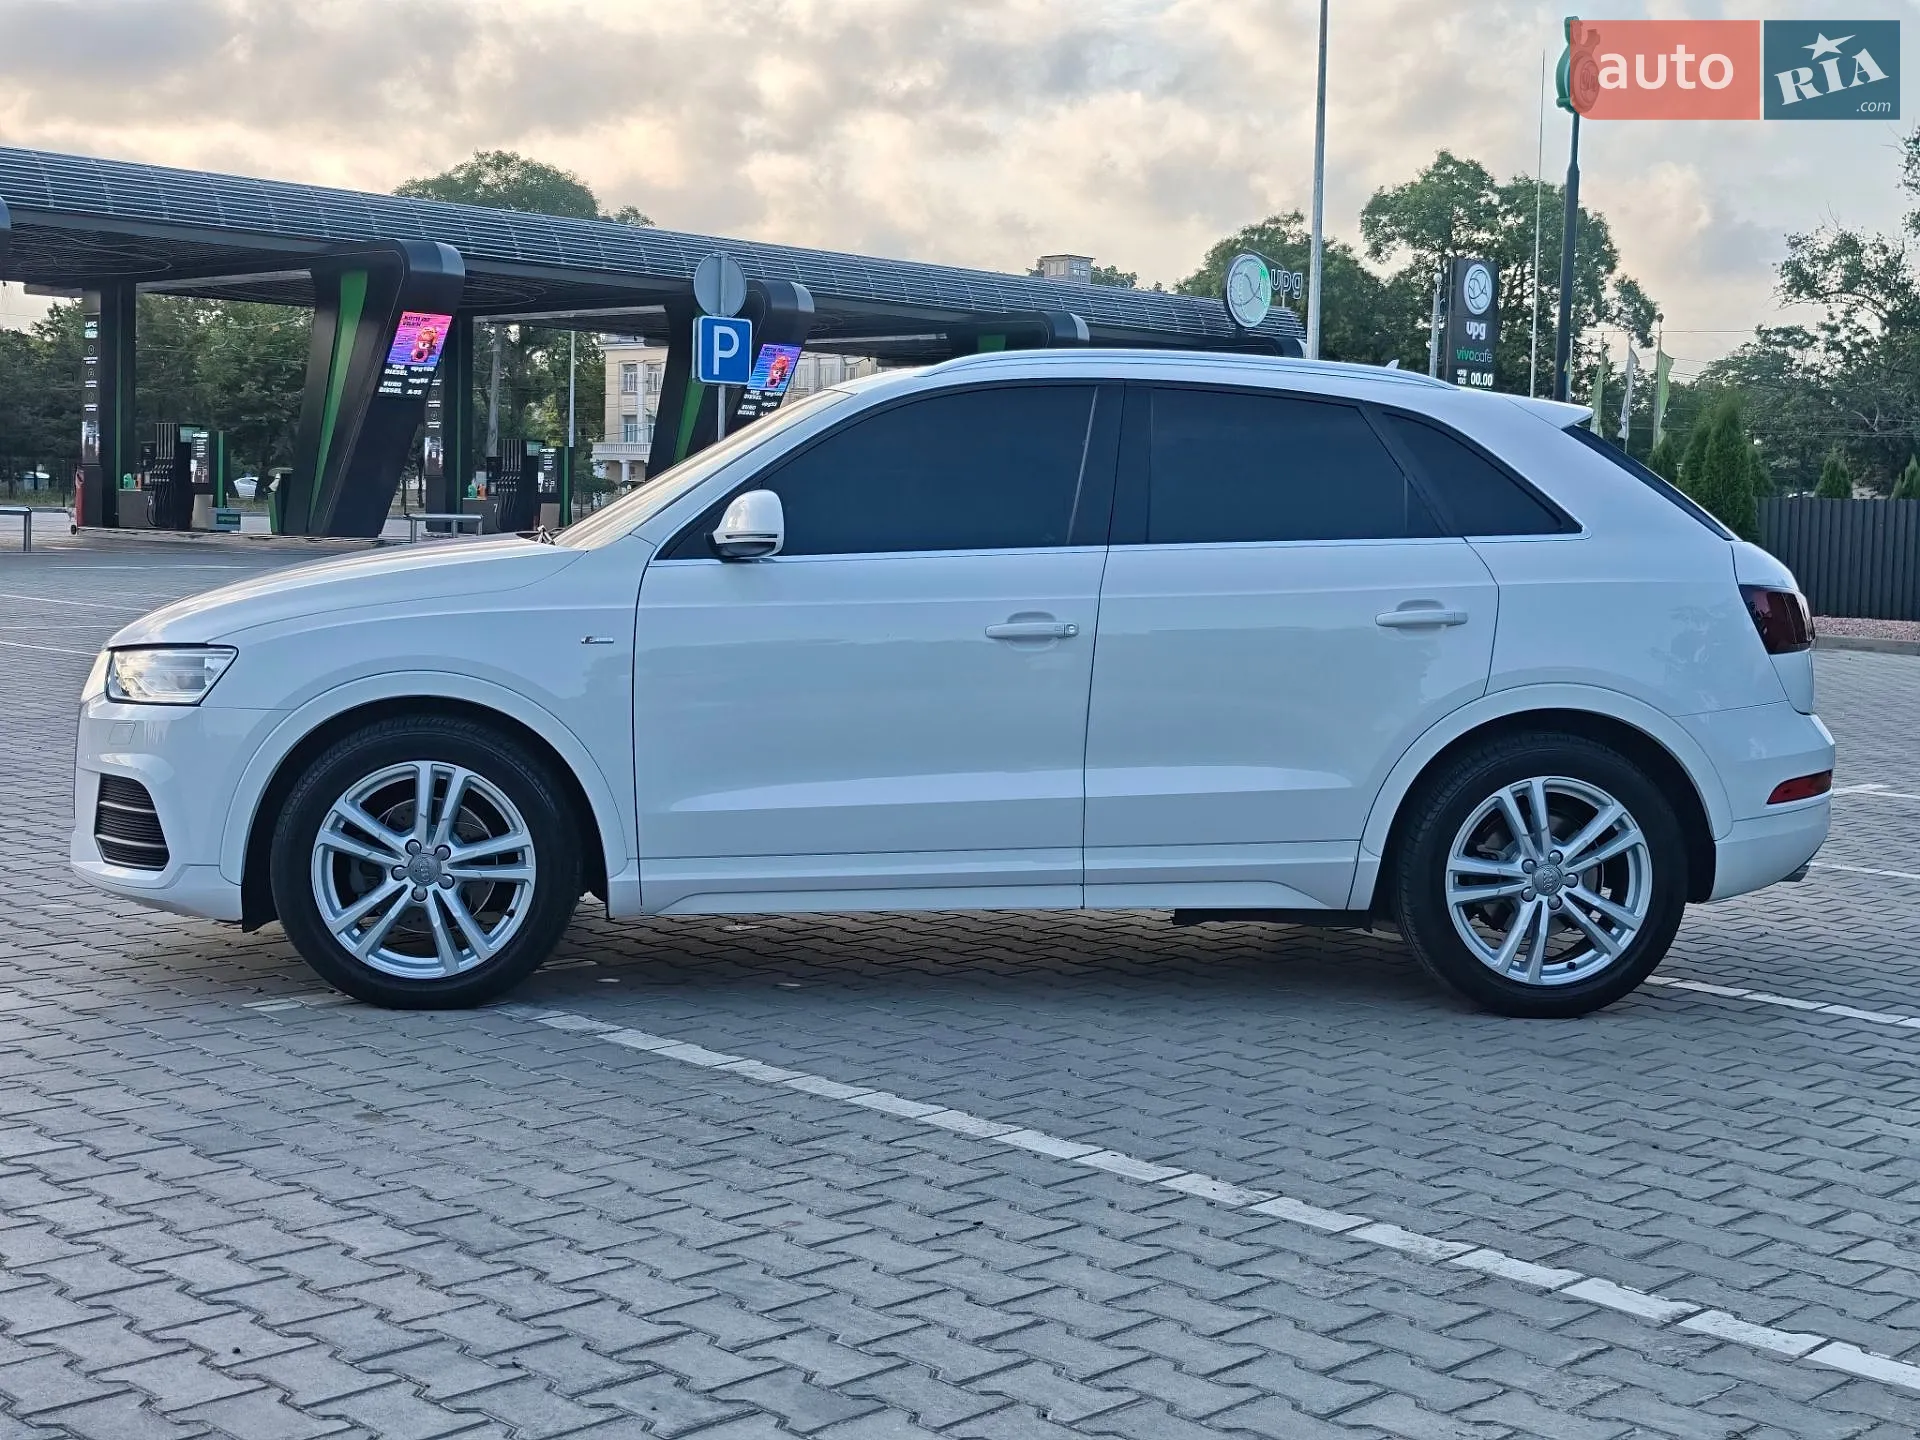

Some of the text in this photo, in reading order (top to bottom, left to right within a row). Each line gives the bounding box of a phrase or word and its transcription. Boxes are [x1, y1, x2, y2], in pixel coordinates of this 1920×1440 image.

[1270, 268, 1303, 300] upg
[1465, 321, 1487, 341] upg
[713, 325, 740, 376] P
[1470, 372, 1494, 387] 00.00
